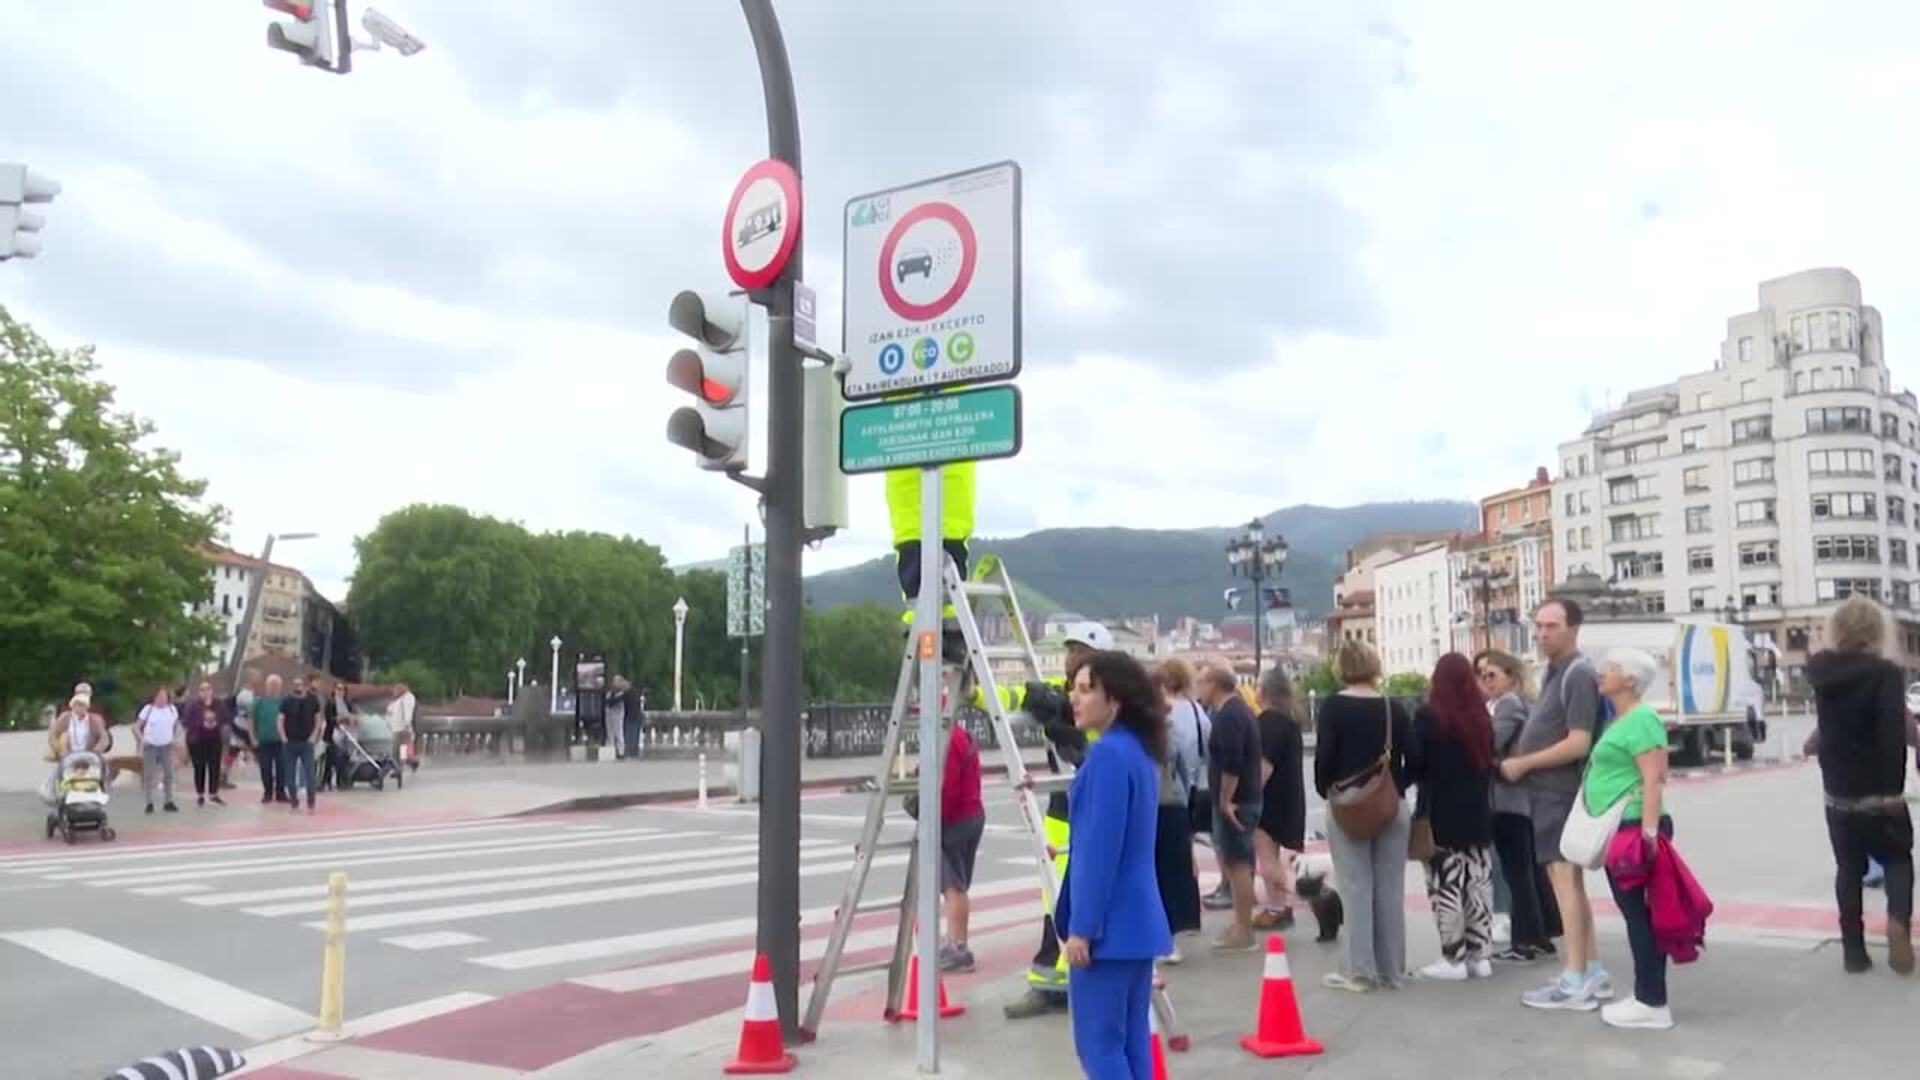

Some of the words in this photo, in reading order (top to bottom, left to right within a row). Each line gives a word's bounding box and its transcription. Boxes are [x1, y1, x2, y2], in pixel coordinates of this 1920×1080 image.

[869, 331, 894, 344] IZAN
[897, 325, 922, 339] EZIK
[930, 314, 985, 332] EXCEPTO
[914, 345, 938, 362] ECO
[846, 381, 863, 394] ETA
[941, 361, 1010, 380] AUTORIZADOS
